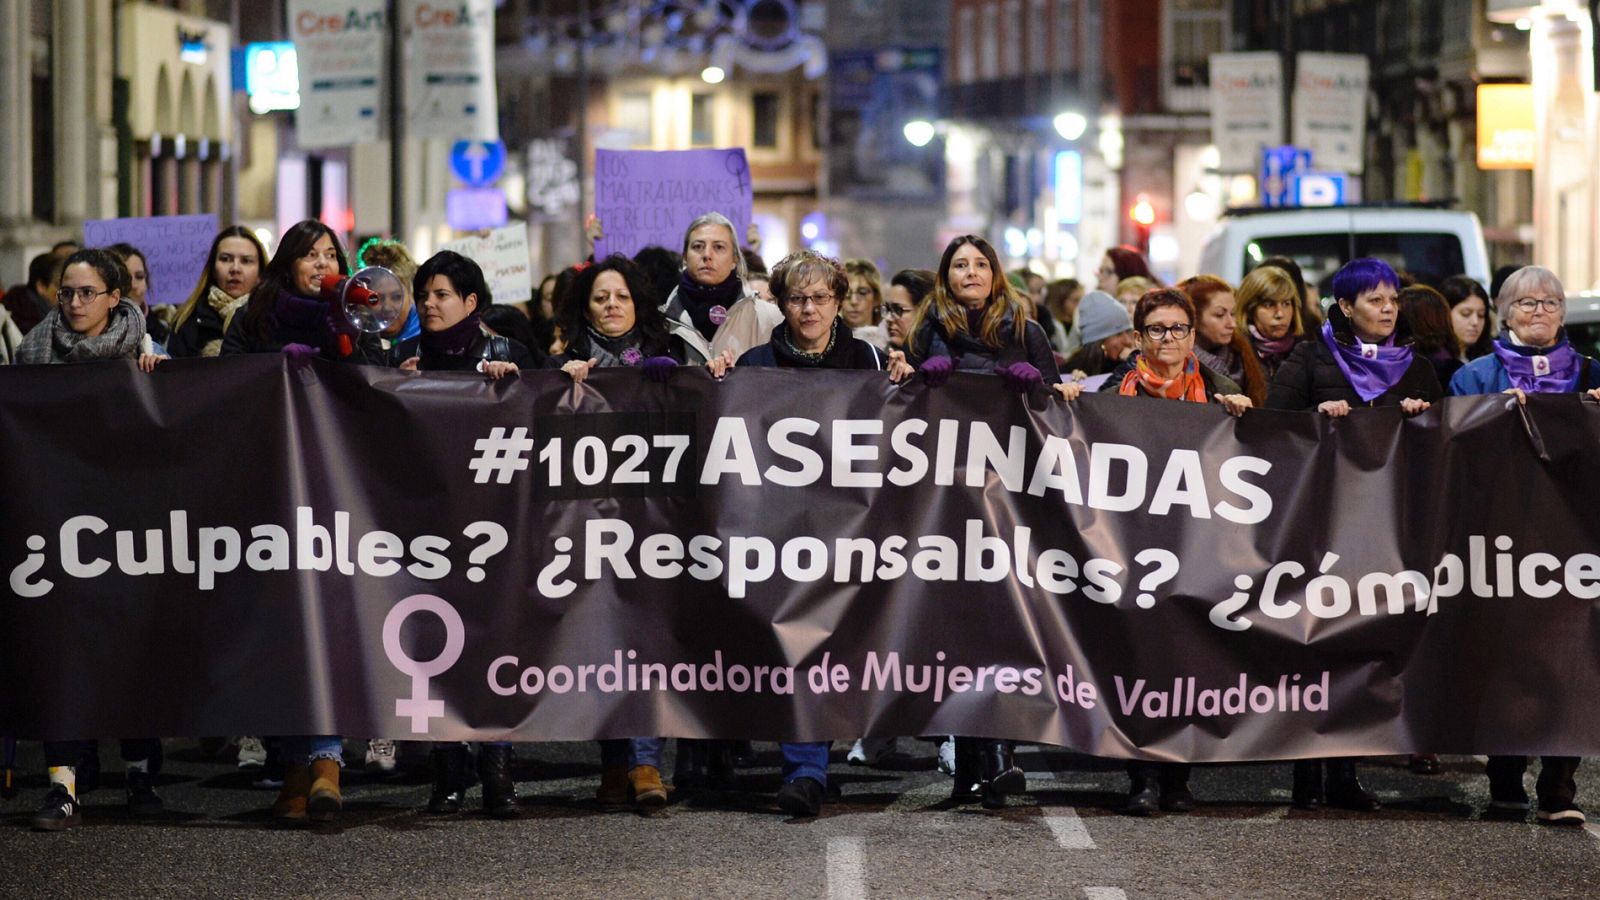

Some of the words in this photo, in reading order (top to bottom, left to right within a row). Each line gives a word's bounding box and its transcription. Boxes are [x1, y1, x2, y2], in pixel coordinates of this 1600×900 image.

[601, 154, 629, 178] LOS
[601, 180, 736, 205] MALTRATADORES
[601, 207, 676, 231] MERECEN
[468, 426, 690, 487] #1027
[700, 416, 1274, 526] ASESINADAS
[9, 505, 509, 597] ¿Culpables?
[536, 518, 1181, 609] ¿Responsables?
[486, 649, 795, 697] Coordinadora
[808, 651, 851, 694] de
[861, 650, 1044, 705] Mujeres
[1057, 662, 1099, 711] de
[1113, 671, 1330, 719] Valladolid
